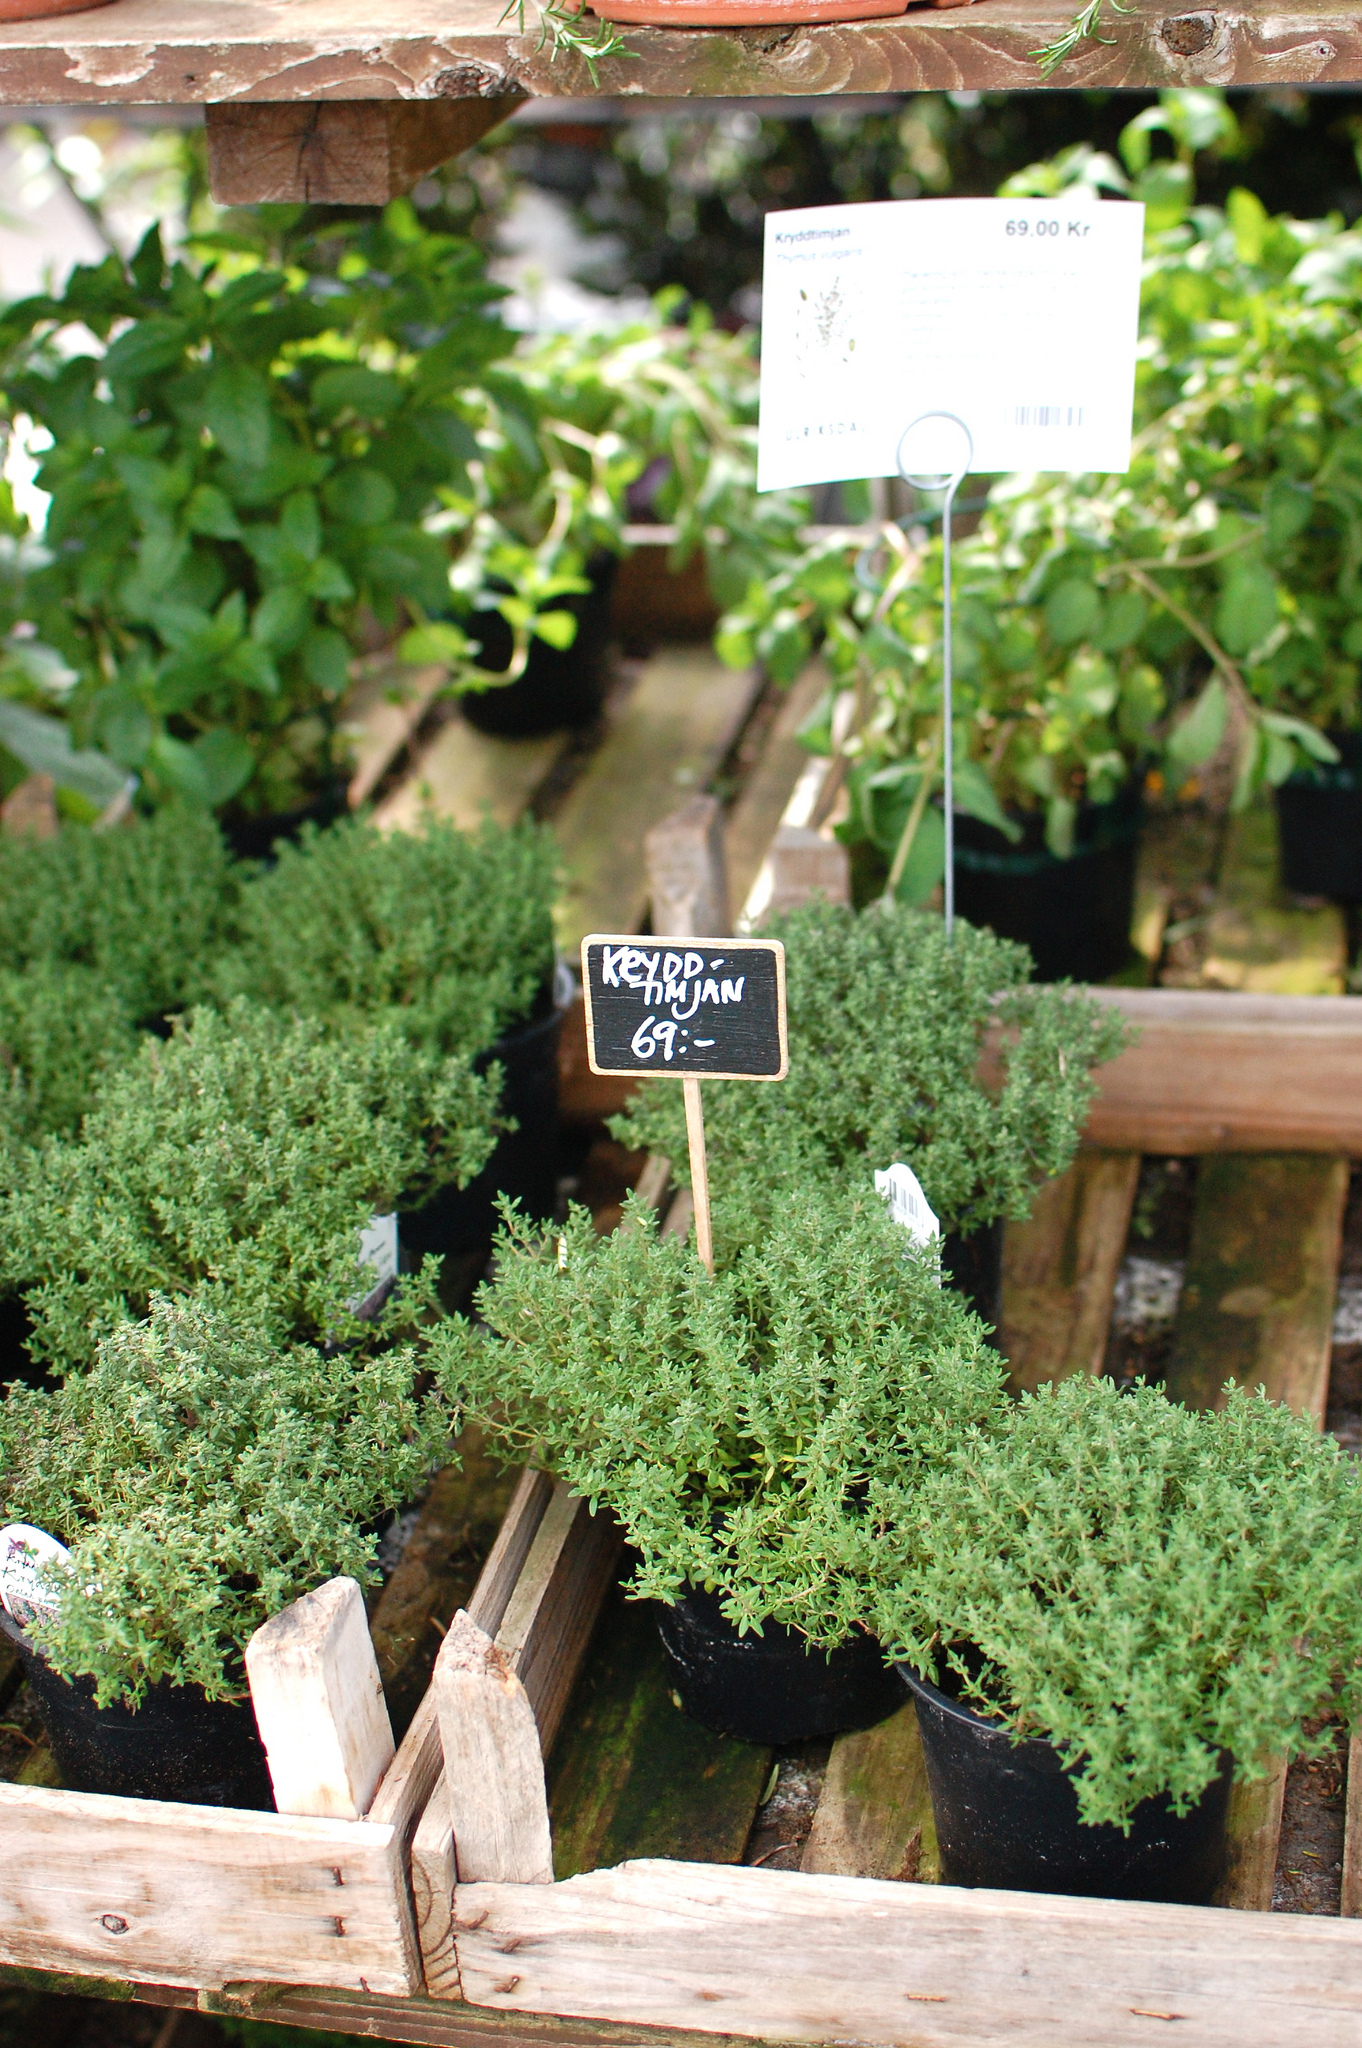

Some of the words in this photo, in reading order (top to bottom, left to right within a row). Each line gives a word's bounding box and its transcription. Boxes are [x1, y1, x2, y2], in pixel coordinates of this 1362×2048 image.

[775, 227, 851, 246] Kryddtimjan
[1005, 219, 1060, 237] 69.00
[1067, 221, 1091, 237] Kr
[628, 976, 745, 1020] TIMJAN
[631, 1014, 716, 1061] 69:-
